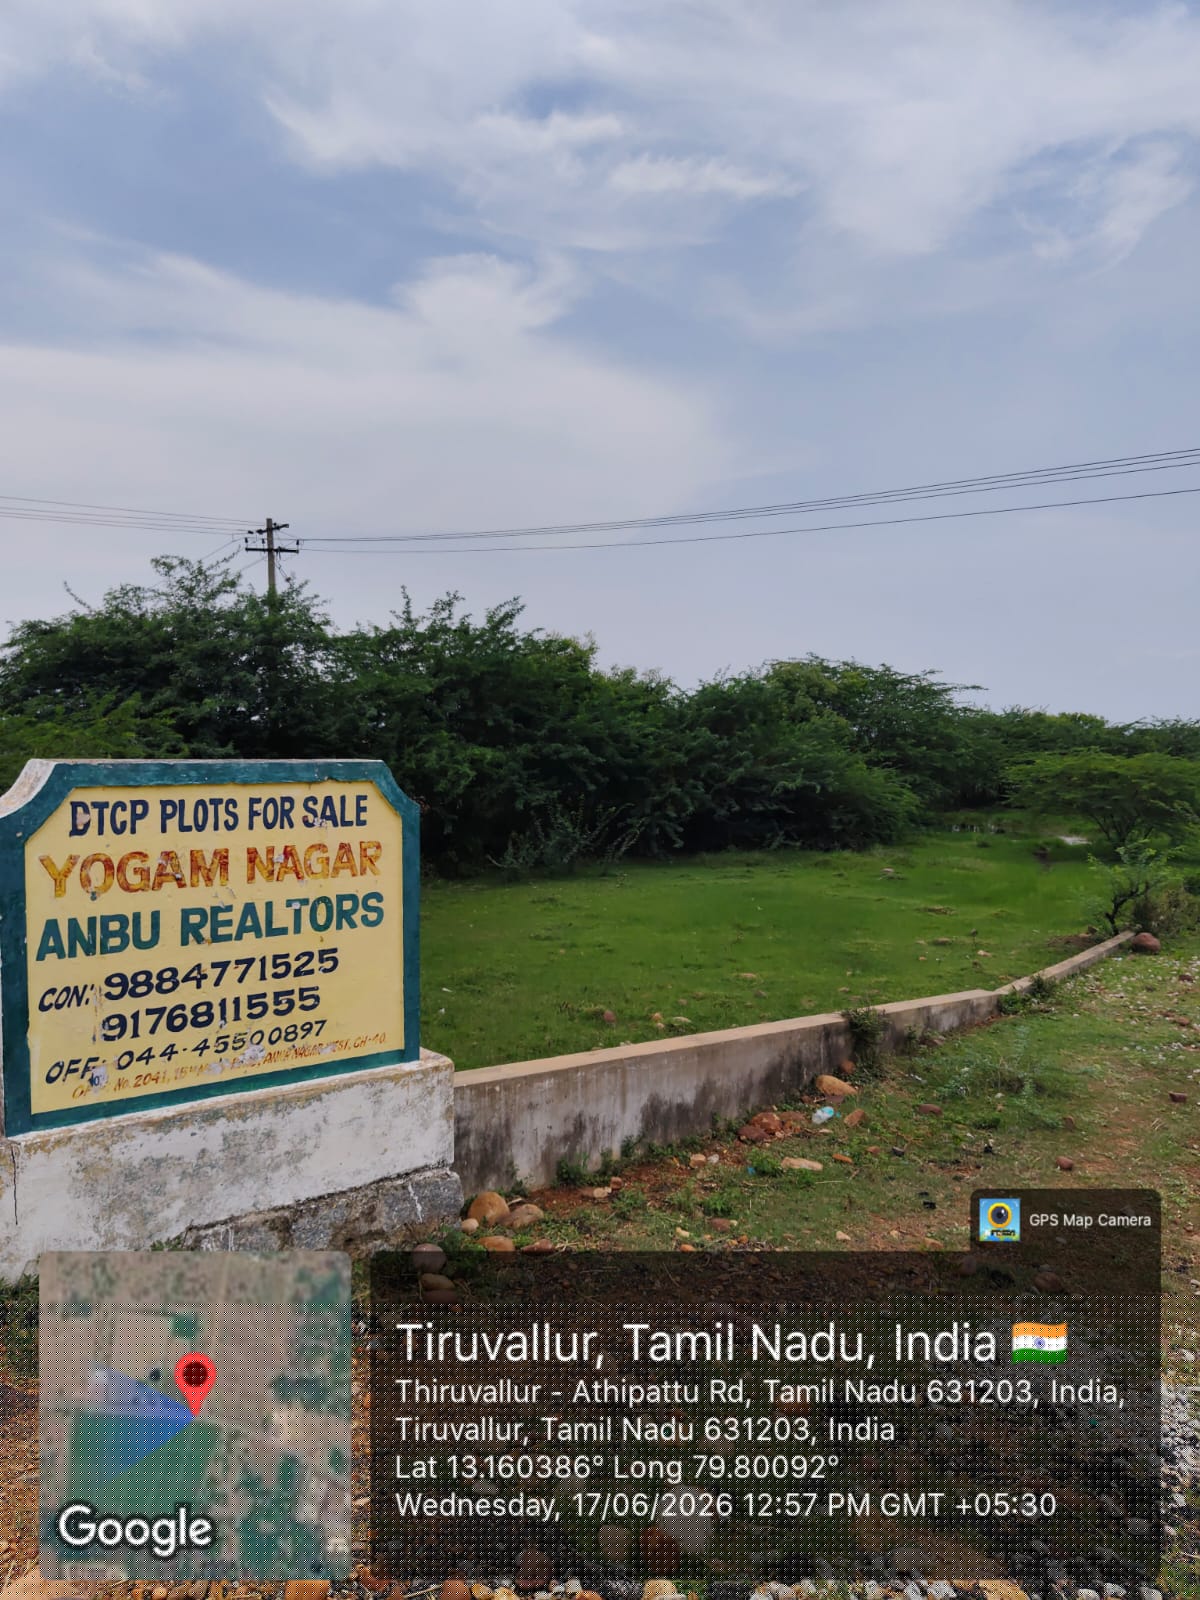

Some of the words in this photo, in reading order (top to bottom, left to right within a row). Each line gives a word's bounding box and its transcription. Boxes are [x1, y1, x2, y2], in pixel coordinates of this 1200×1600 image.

[69, 800, 148, 837] DTCP
[160, 798, 239, 833] PLOTS
[248, 796, 295, 831] FOR
[302, 795, 368, 828] SALE
[39, 848, 229, 898] YOGAM
[246, 840, 382, 883] NAGAR
[36, 910, 160, 961] ANBU
[180, 891, 384, 947] REALTORS
[103, 947, 339, 1001] 9884771525
[102, 986, 320, 1042] 9176811555
